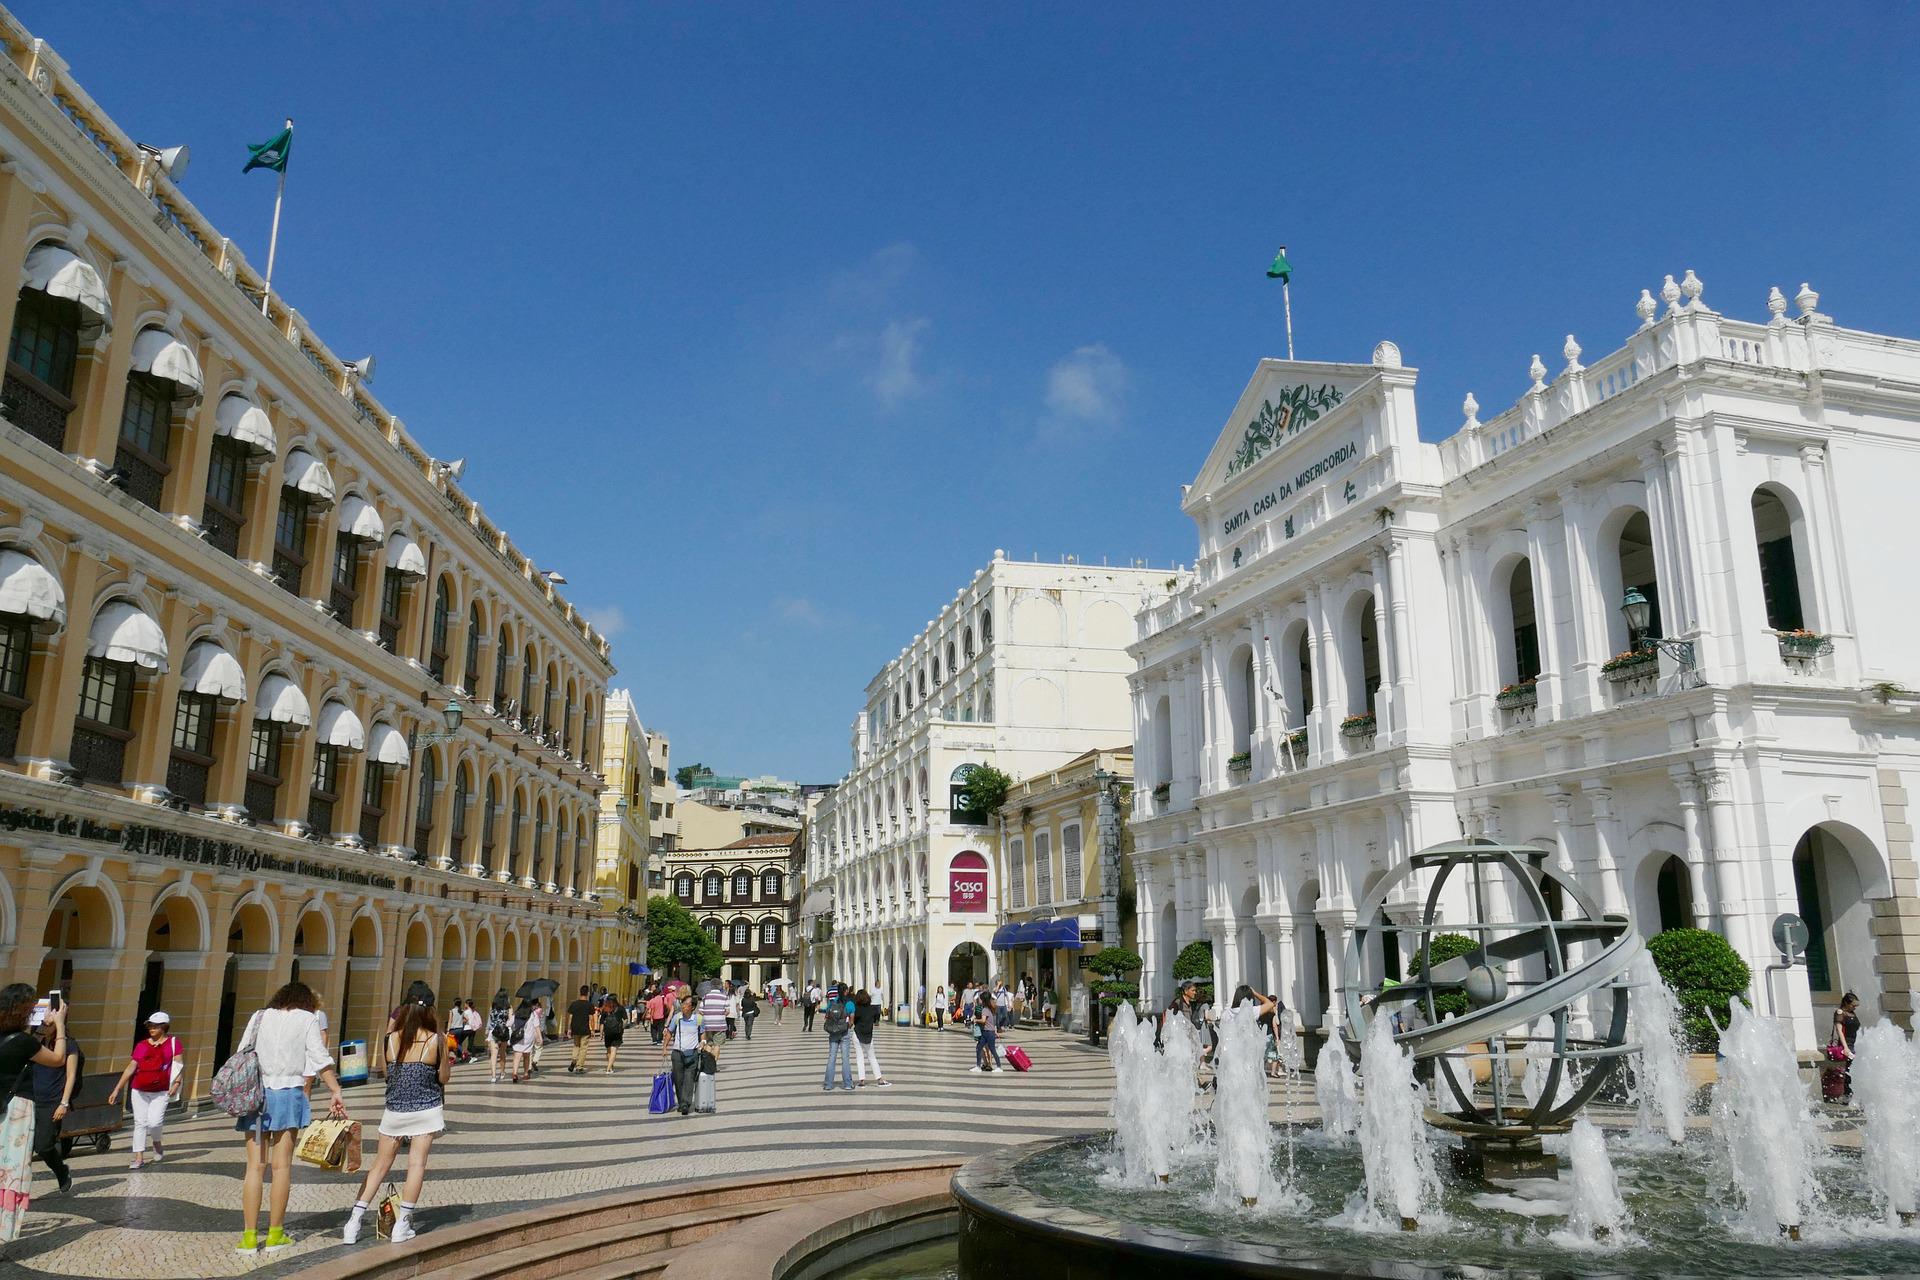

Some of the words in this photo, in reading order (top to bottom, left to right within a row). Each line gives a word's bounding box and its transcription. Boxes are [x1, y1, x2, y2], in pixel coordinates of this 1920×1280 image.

[1224, 509, 1250, 534] SANTA
[1253, 492, 1277, 516] CASA
[1280, 482, 1292, 500] DA
[1295, 441, 1357, 491] MISERICORDIA
[953, 793, 972, 811] IS
